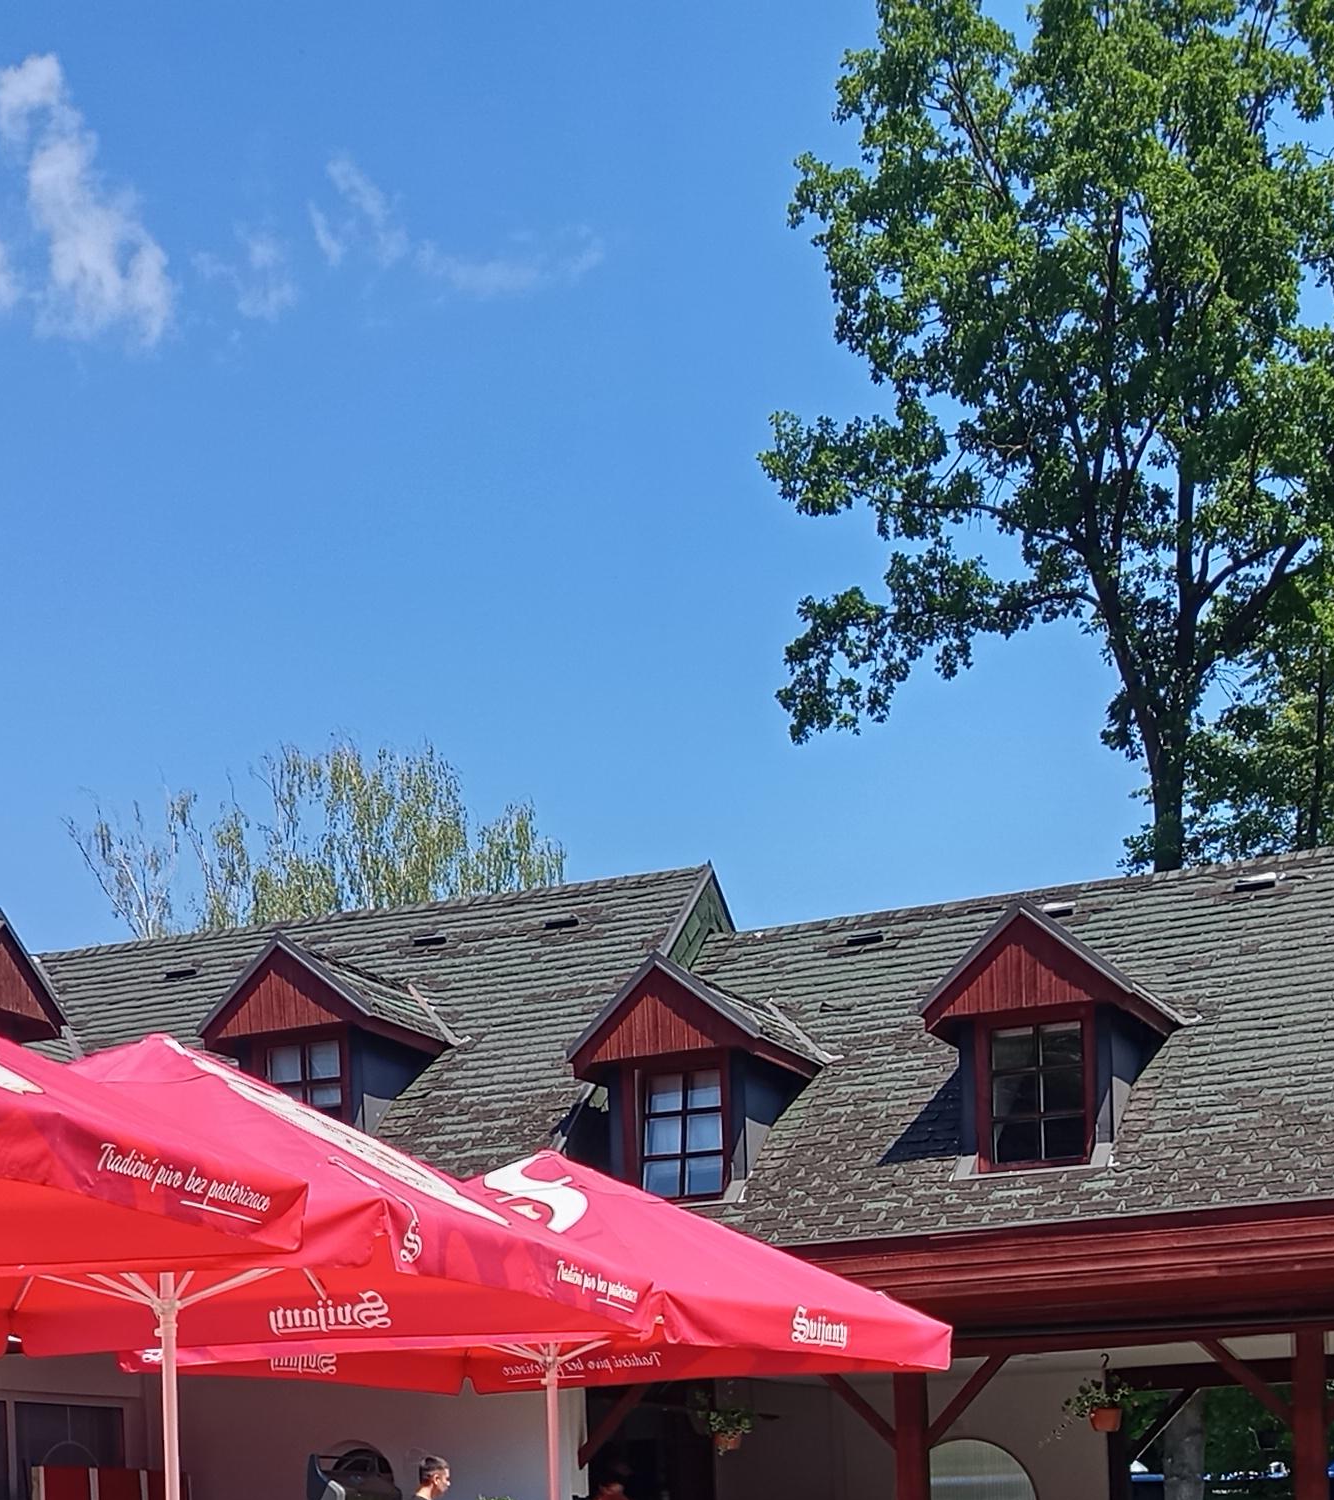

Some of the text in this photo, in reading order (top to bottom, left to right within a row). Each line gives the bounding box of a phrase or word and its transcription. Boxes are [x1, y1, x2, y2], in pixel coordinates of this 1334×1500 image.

[97, 1143, 271, 1212] Tradiční pivo bez pasterizace
[791, 1305, 848, 1350] Svijany
